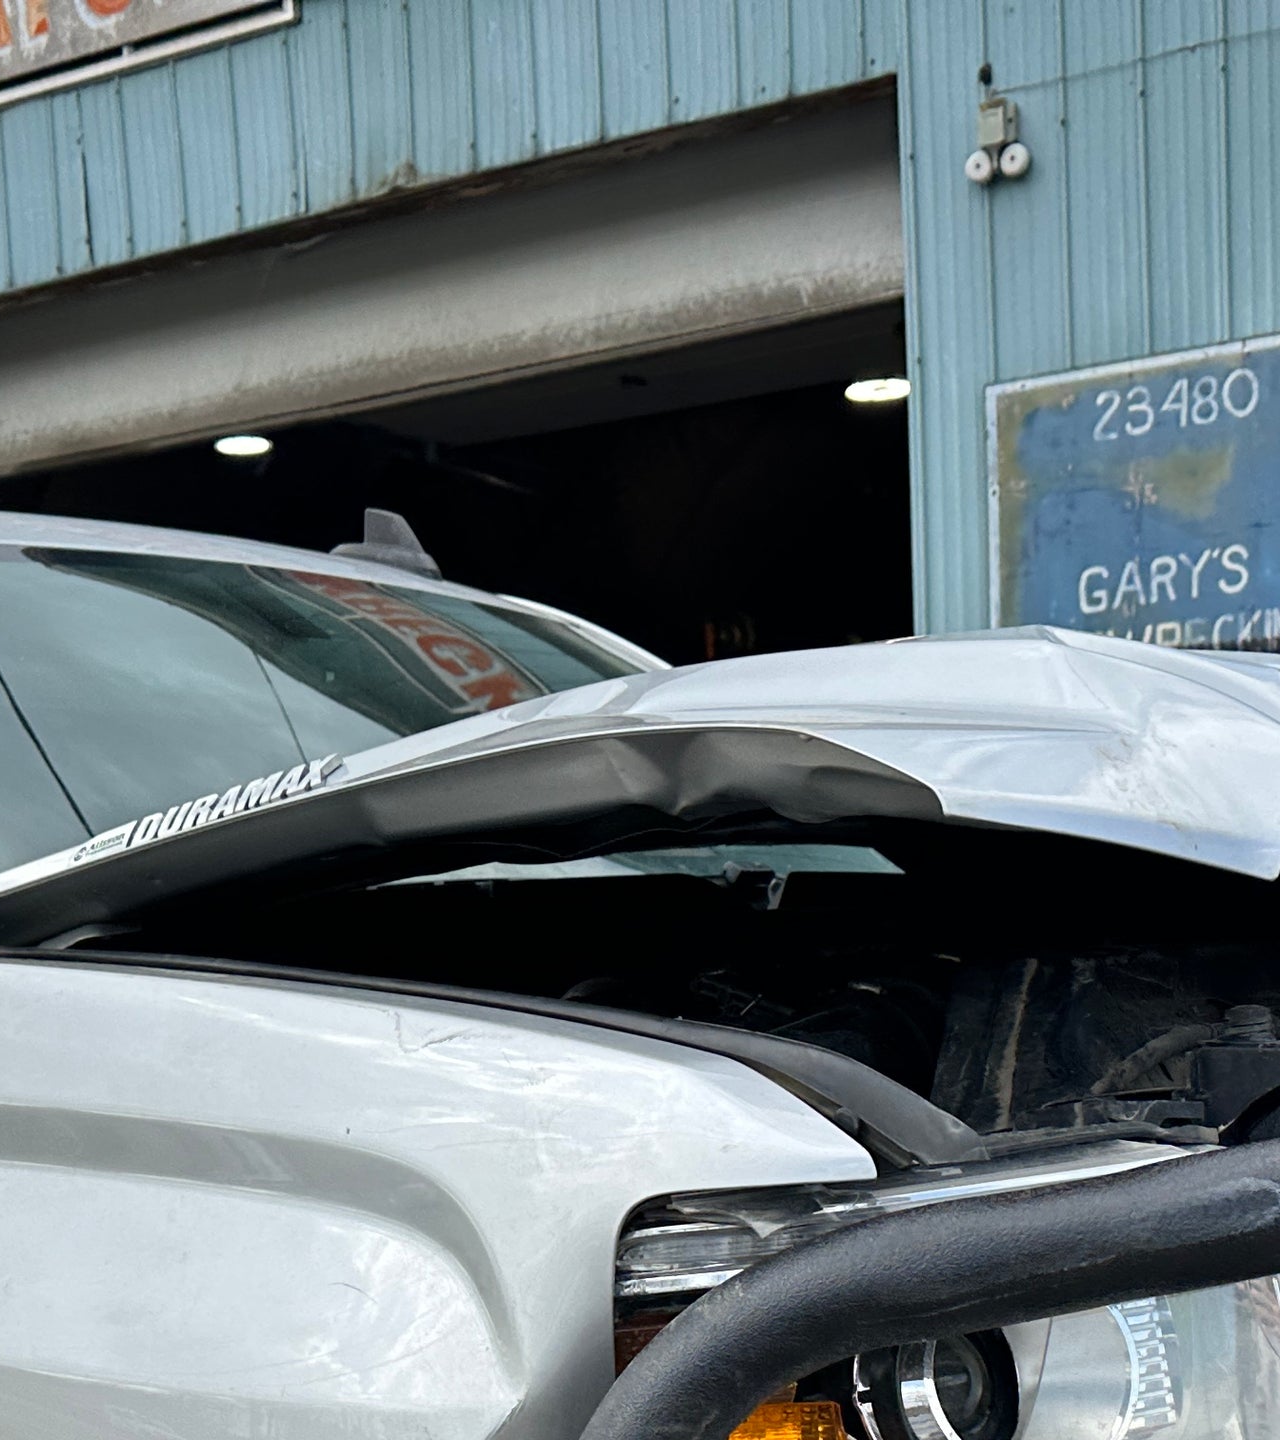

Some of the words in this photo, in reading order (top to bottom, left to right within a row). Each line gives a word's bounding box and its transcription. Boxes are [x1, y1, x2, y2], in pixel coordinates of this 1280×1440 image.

[1092, 368, 1259, 441] 23480
[1078, 543, 1250, 614] GARY'S
[132, 752, 345, 849] DURAMAX
